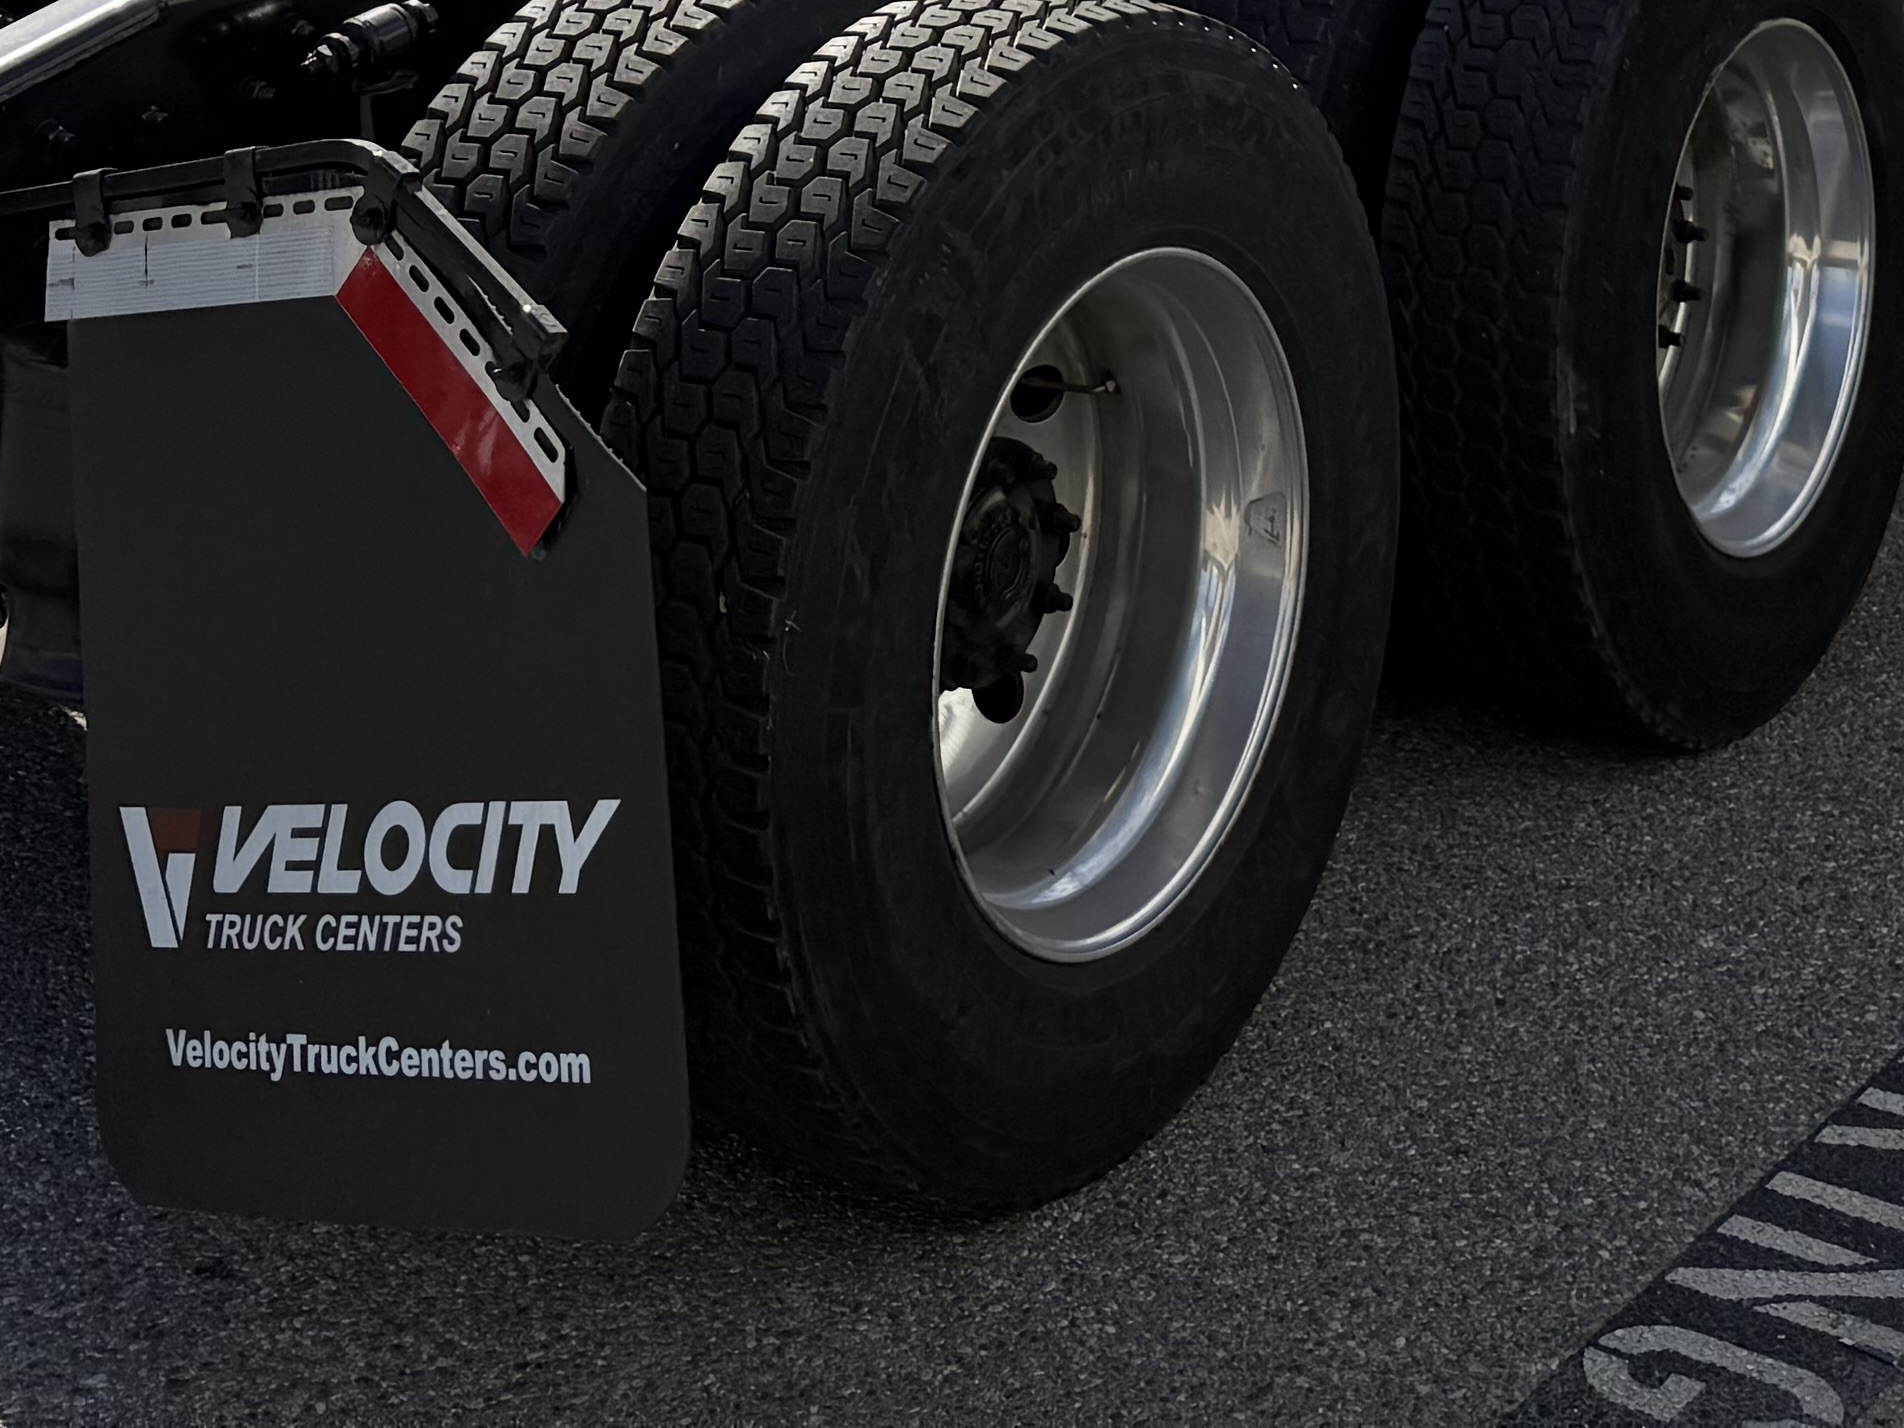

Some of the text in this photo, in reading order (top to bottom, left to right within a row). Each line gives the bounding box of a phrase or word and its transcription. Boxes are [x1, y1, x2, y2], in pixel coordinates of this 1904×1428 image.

[212, 798, 621, 896] VELOCITY
[205, 912, 464, 953] TRUCK CENTERS
[165, 1028, 592, 1085] VelocityTruckCenters.com
